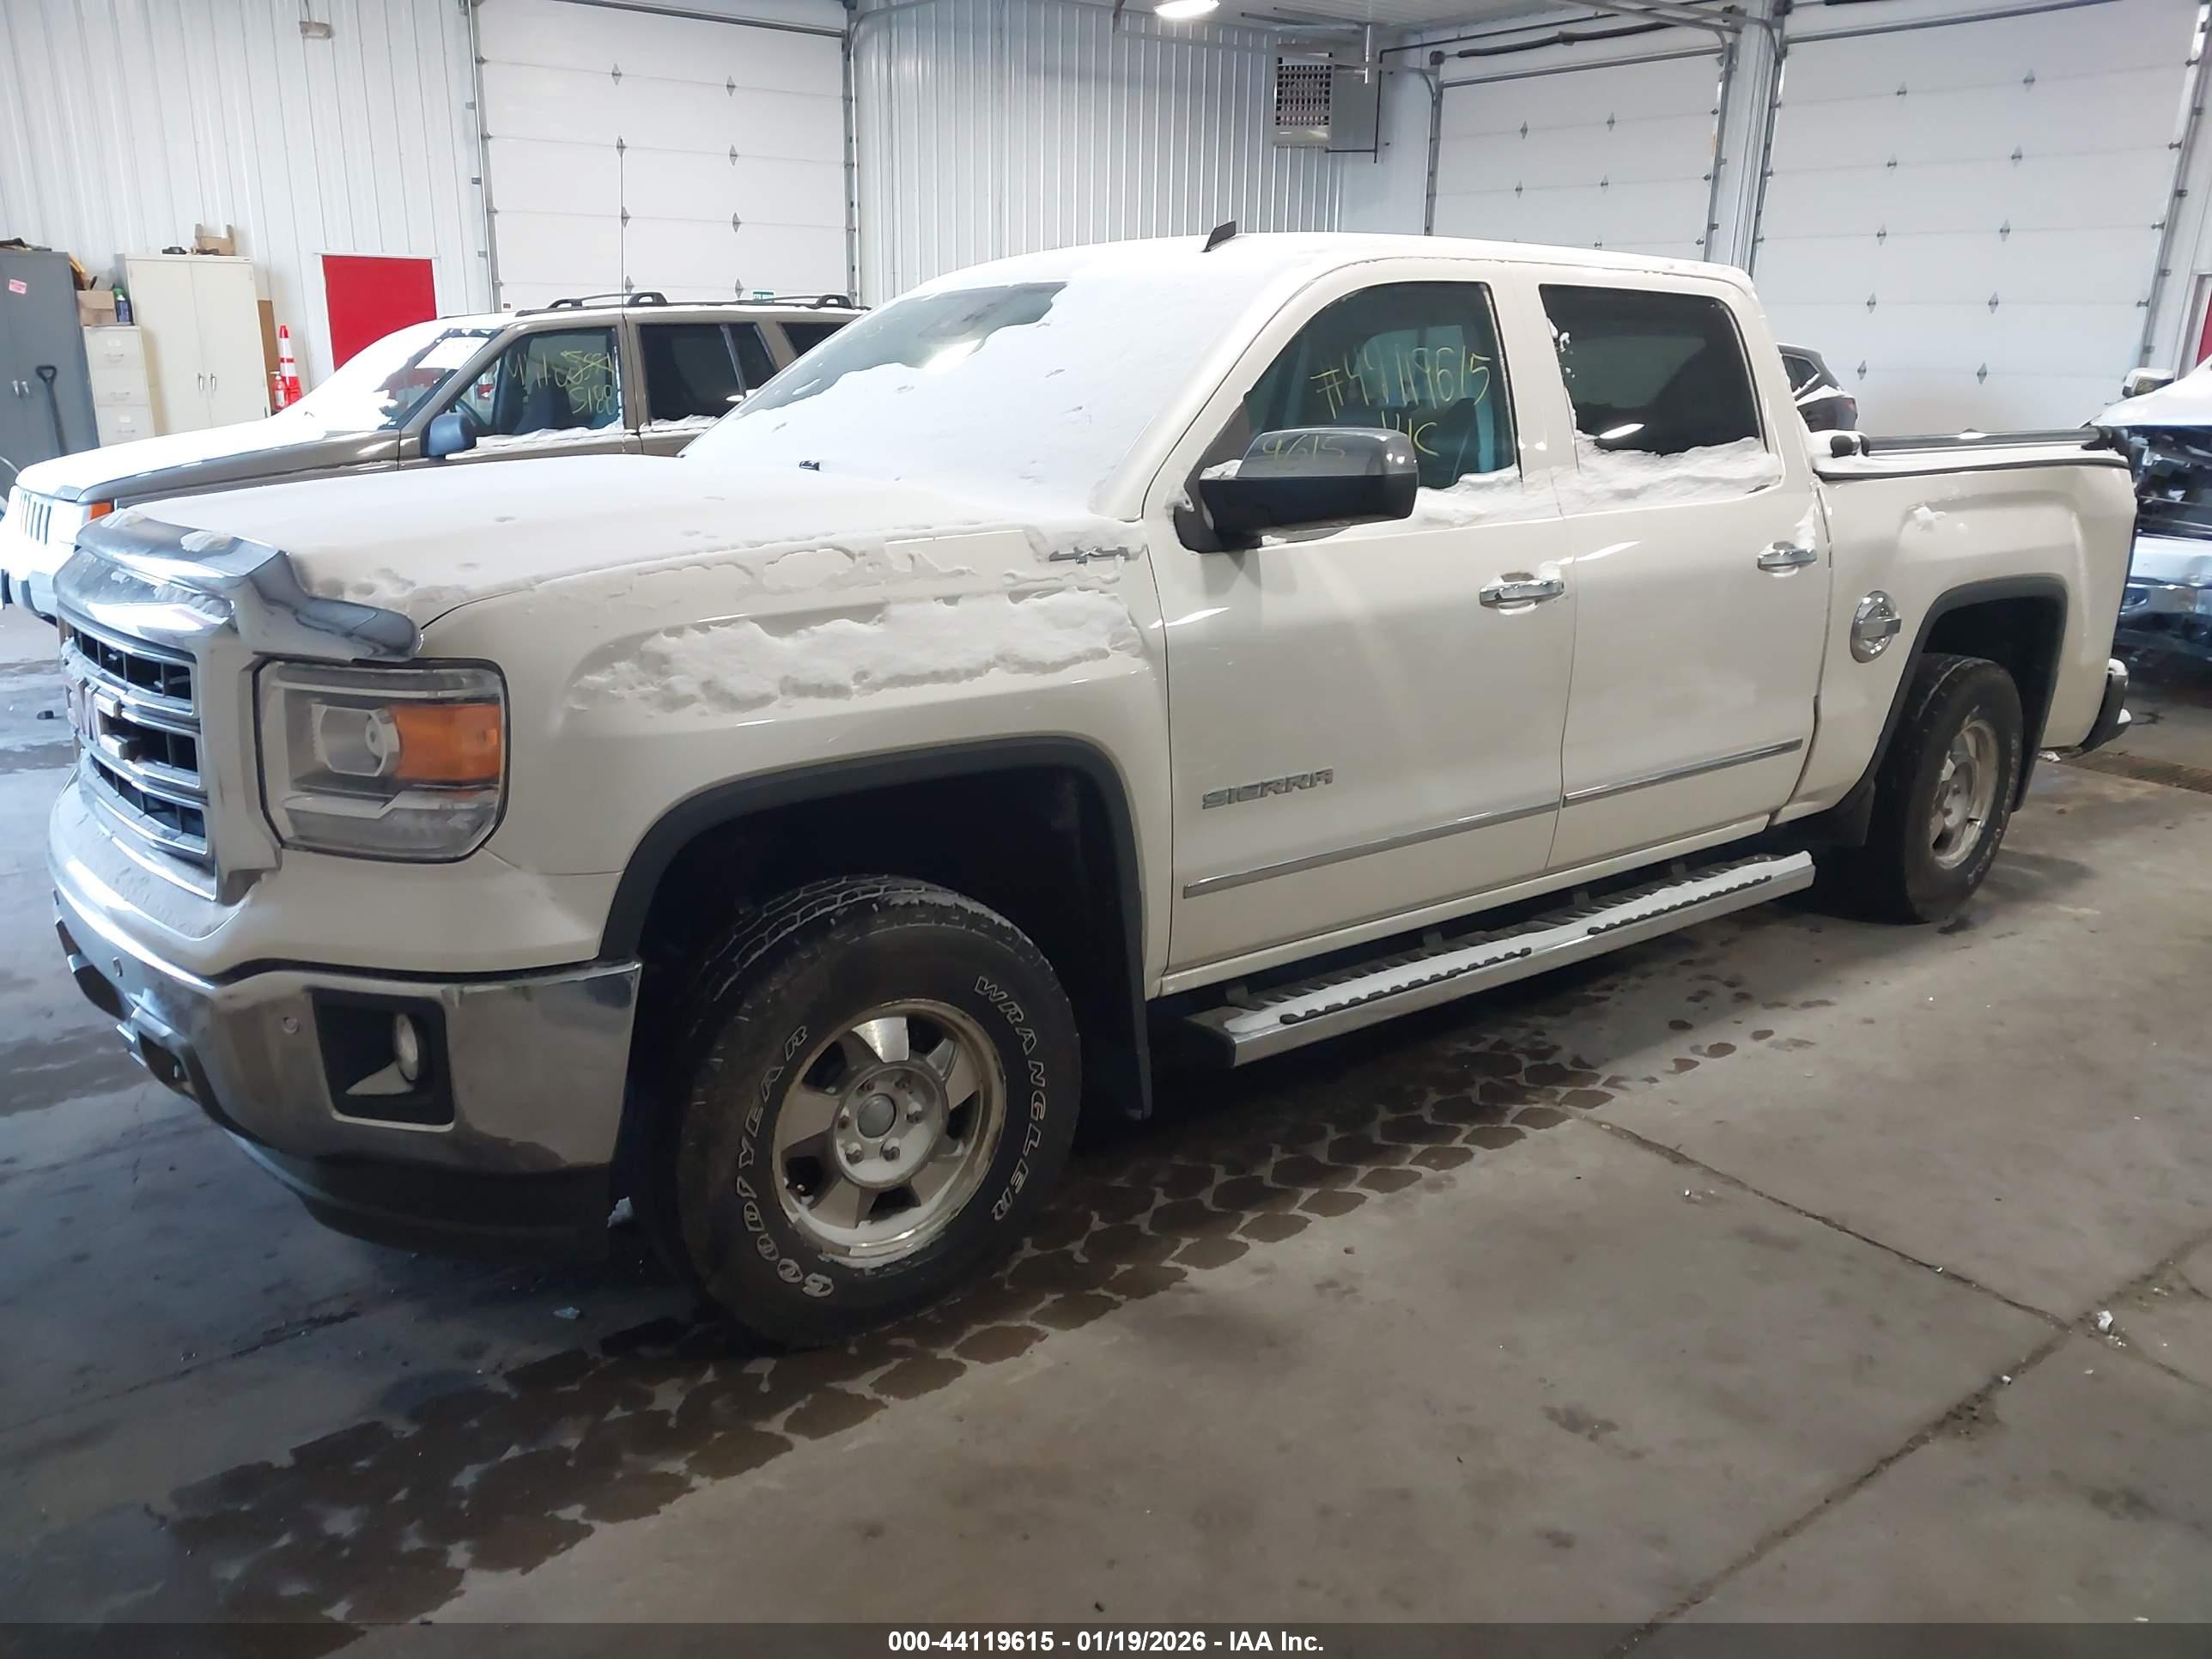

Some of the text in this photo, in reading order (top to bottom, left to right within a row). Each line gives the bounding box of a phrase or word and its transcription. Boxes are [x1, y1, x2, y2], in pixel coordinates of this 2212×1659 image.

[1201, 767, 1334, 810] SIERRA
[736, 1025, 834, 1298] GOODYEAR
[974, 975, 1047, 1223] WRANGLER
